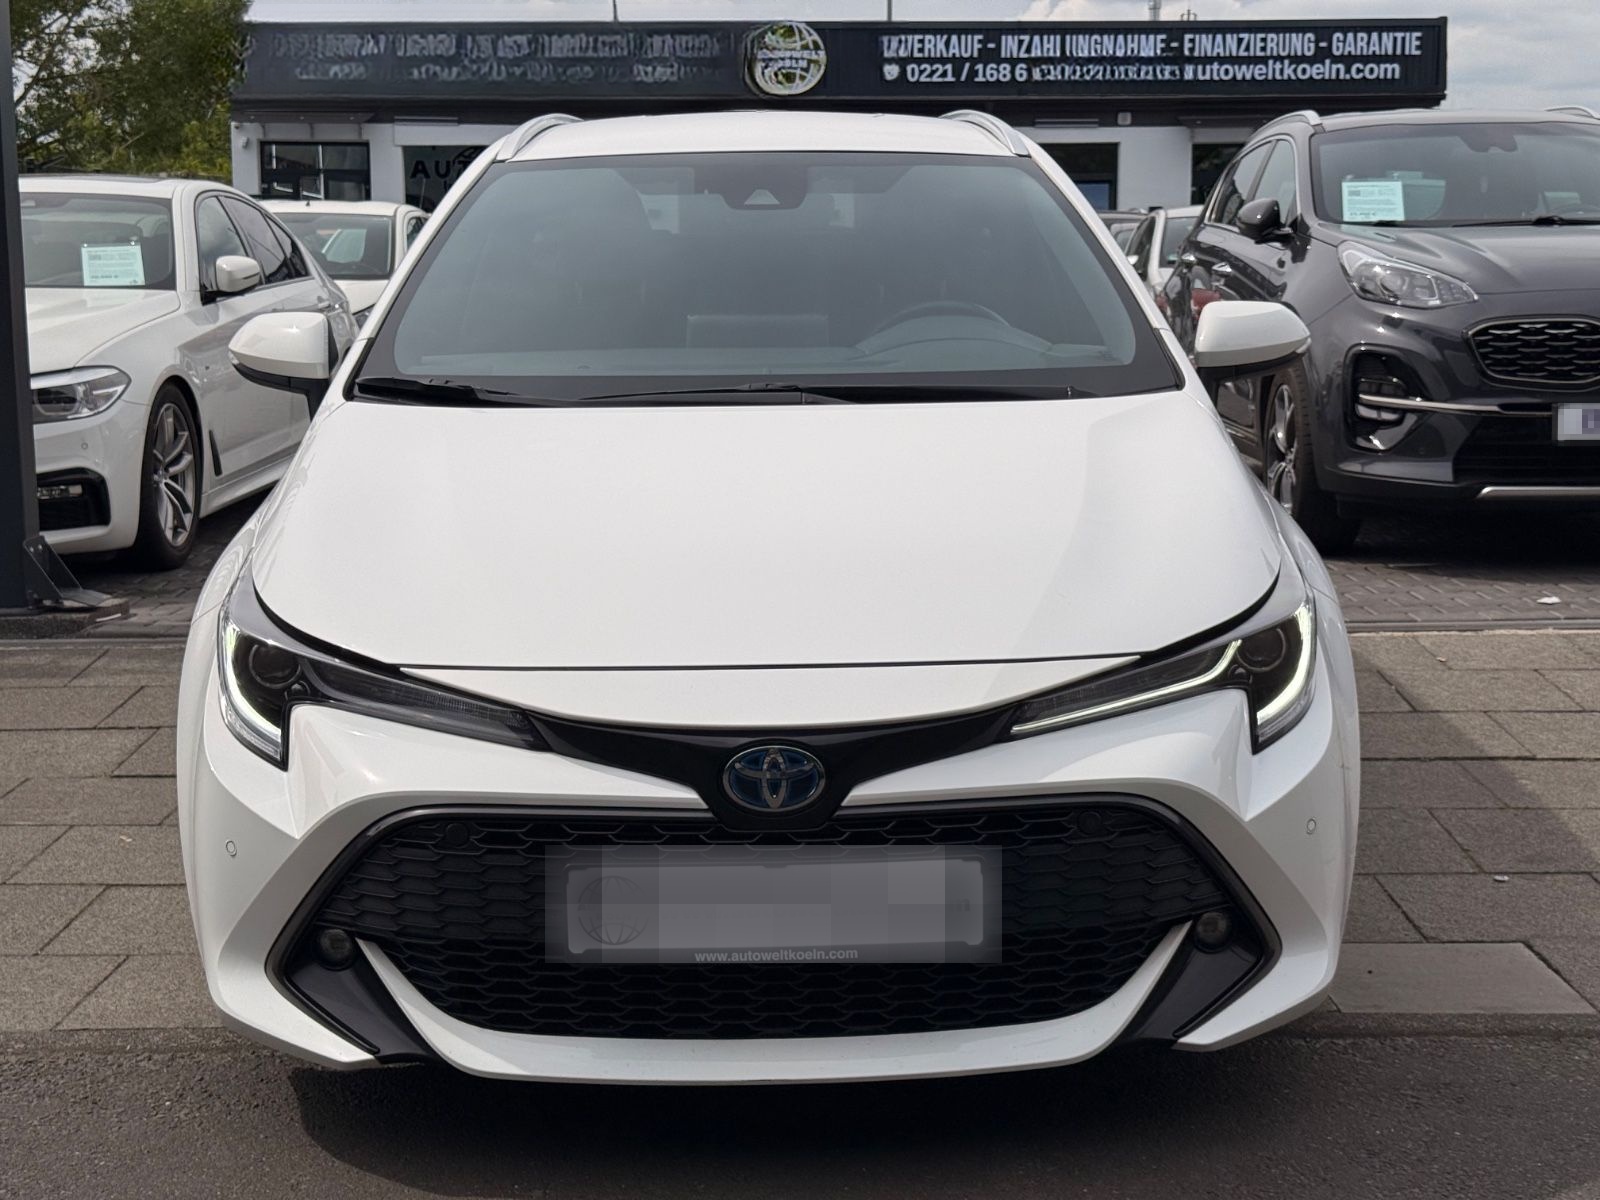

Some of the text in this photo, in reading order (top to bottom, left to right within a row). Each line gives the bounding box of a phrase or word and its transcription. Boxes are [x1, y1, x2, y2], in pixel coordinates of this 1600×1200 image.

[1184, 33, 1315, 57] FINANZIERUNG
[1332, 32, 1422, 56] GARANTIE
[906, 63, 956, 82] 0221
[1184, 59, 1400, 81] utoweltkoeln.com
[694, 948, 859, 963] www.autoweltkoeln.com
